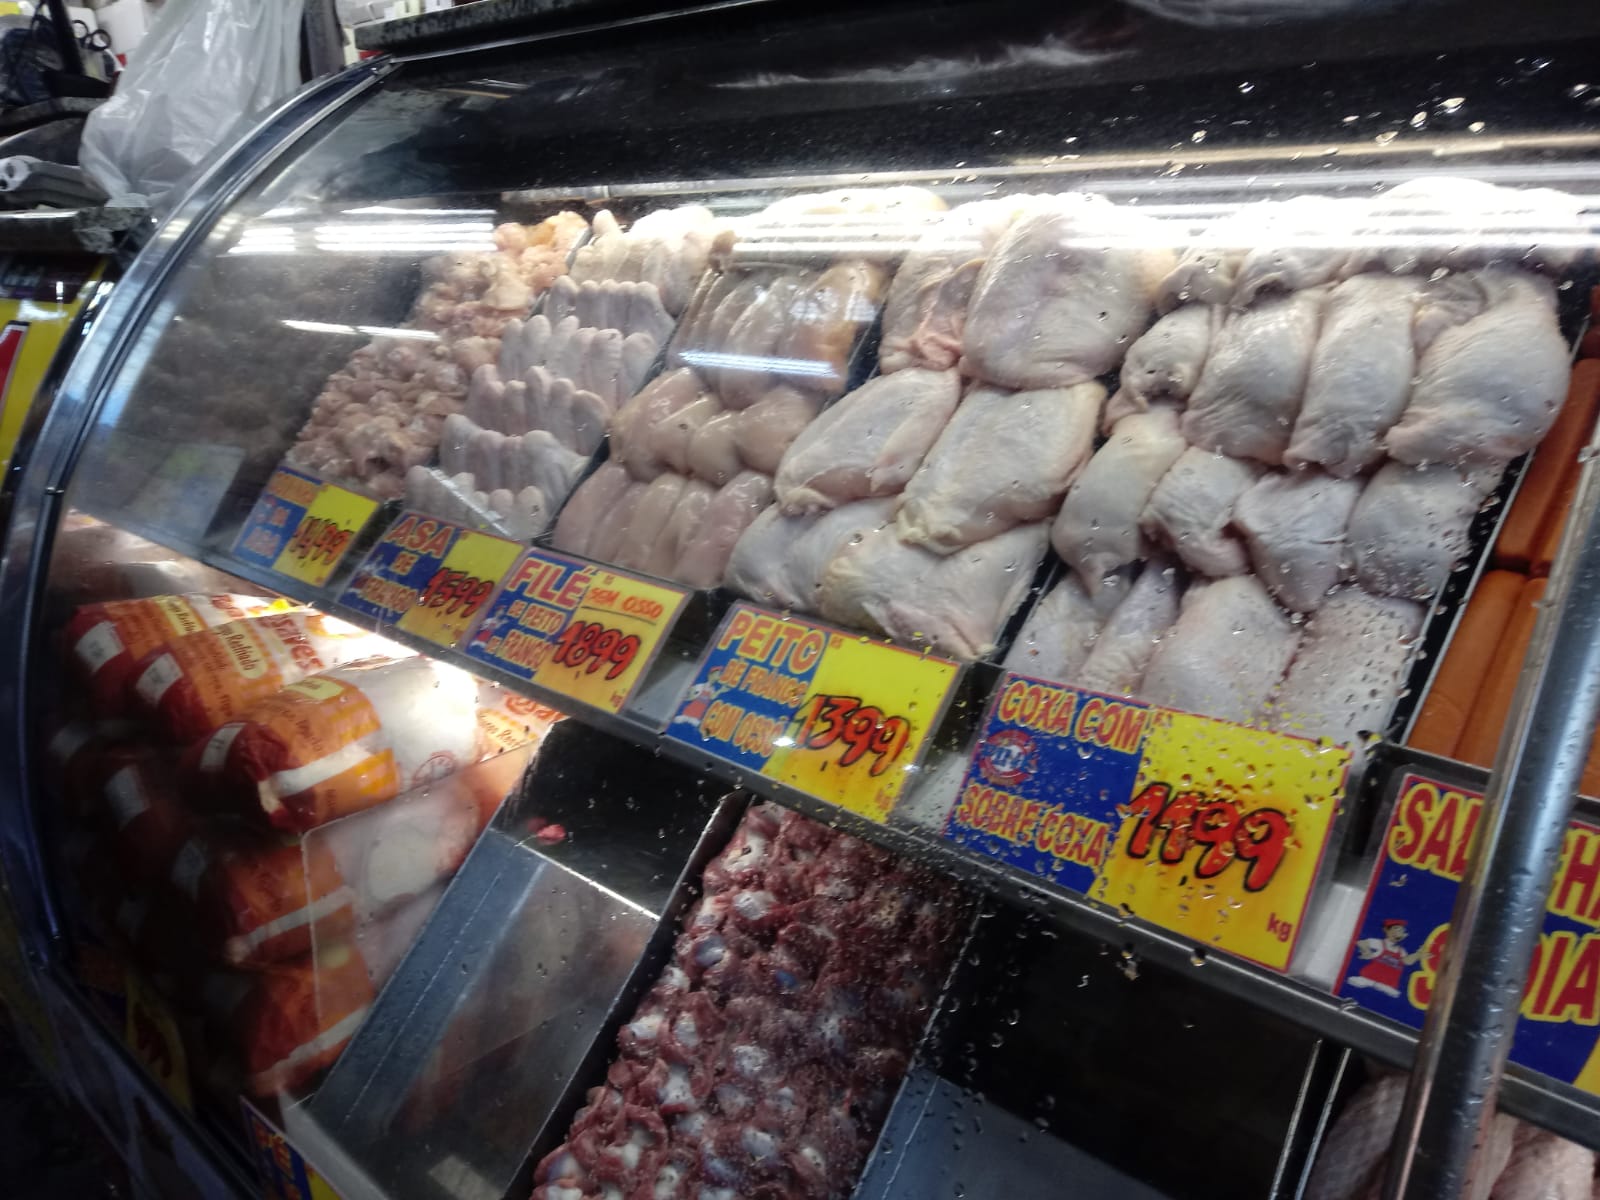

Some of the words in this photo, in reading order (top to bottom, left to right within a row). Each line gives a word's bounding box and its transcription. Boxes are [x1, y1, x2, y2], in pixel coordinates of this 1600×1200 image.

[383, 515, 455, 559] ASA
[505, 557, 597, 610] FILÉ
[518, 603, 567, 635] PEITO
[622, 596, 664, 620] OSSO
[502, 629, 557, 671] FRANGO
[717, 609, 826, 674] PEITO
[719, 658, 748, 687] DE
[739, 665, 809, 708] FRANGO
[701, 699, 745, 742] COM
[998, 680, 1078, 737] COXA
[1075, 697, 1150, 754] COM
[956, 782, 1040, 846] SOBRE
[1035, 809, 1110, 866] COXA
[1266, 912, 1294, 943] kg
